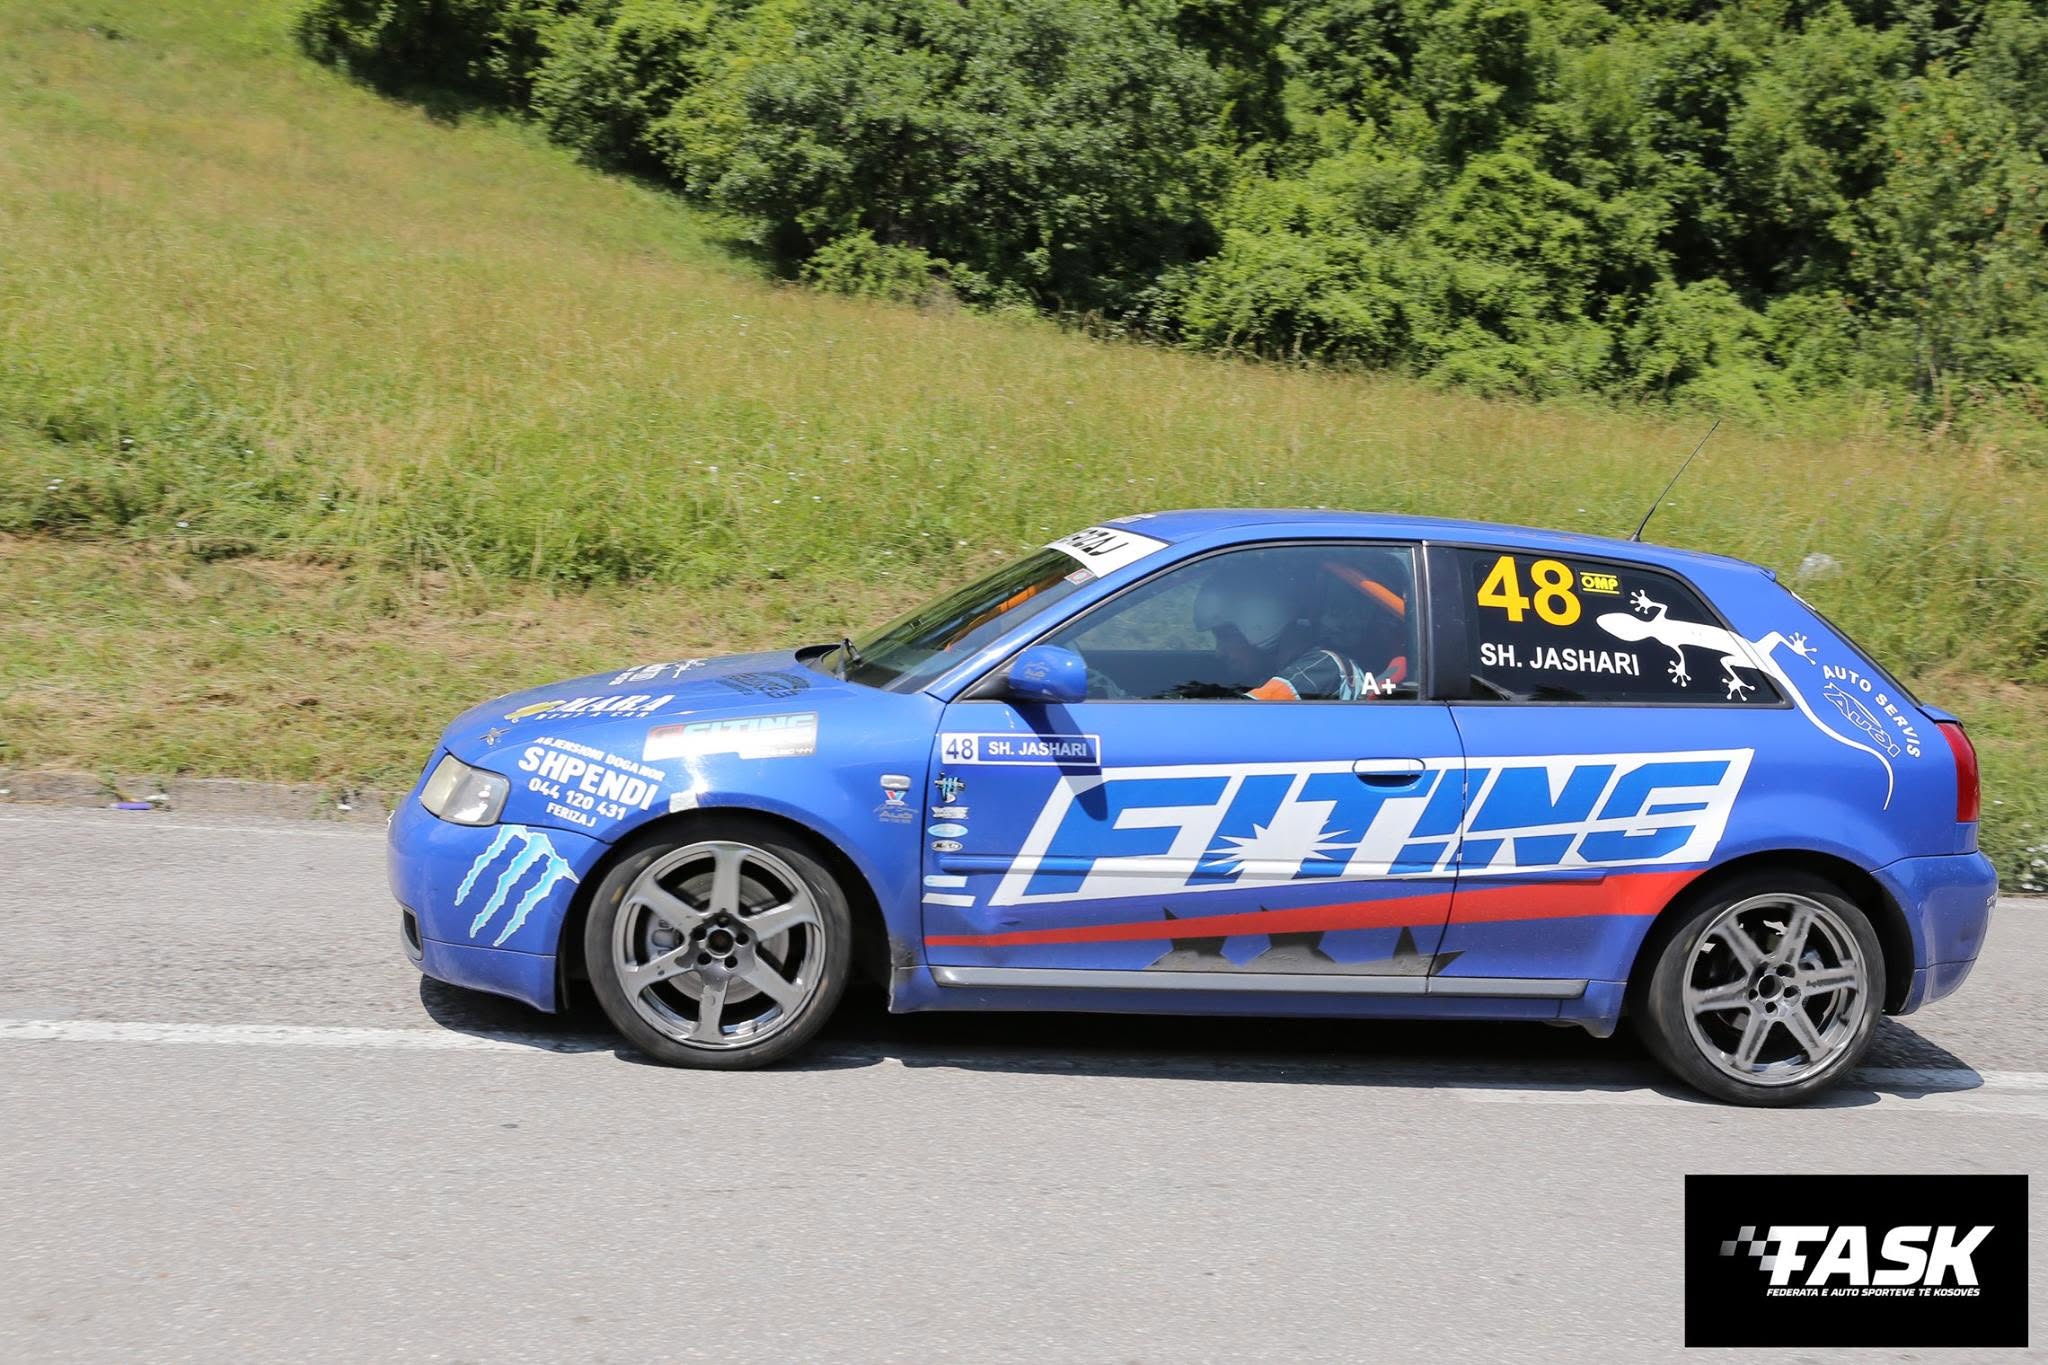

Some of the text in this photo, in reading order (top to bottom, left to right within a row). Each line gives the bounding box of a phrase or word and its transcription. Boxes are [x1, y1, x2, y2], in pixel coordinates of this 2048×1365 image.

[1477, 555, 1582, 626] 48
[1581, 576, 1619, 591] OMP
[1480, 642, 1640, 676] SH. JASHARI
[1361, 671, 1397, 695] A+
[1823, 664, 1921, 758] AUTO SERVIS
[945, 738, 1088, 760] 48 SH. JASHARI
[517, 746, 660, 811] SHPENDI
[528, 777, 628, 821] 044 120 431
[545, 801, 598, 828] FERIZAJ
